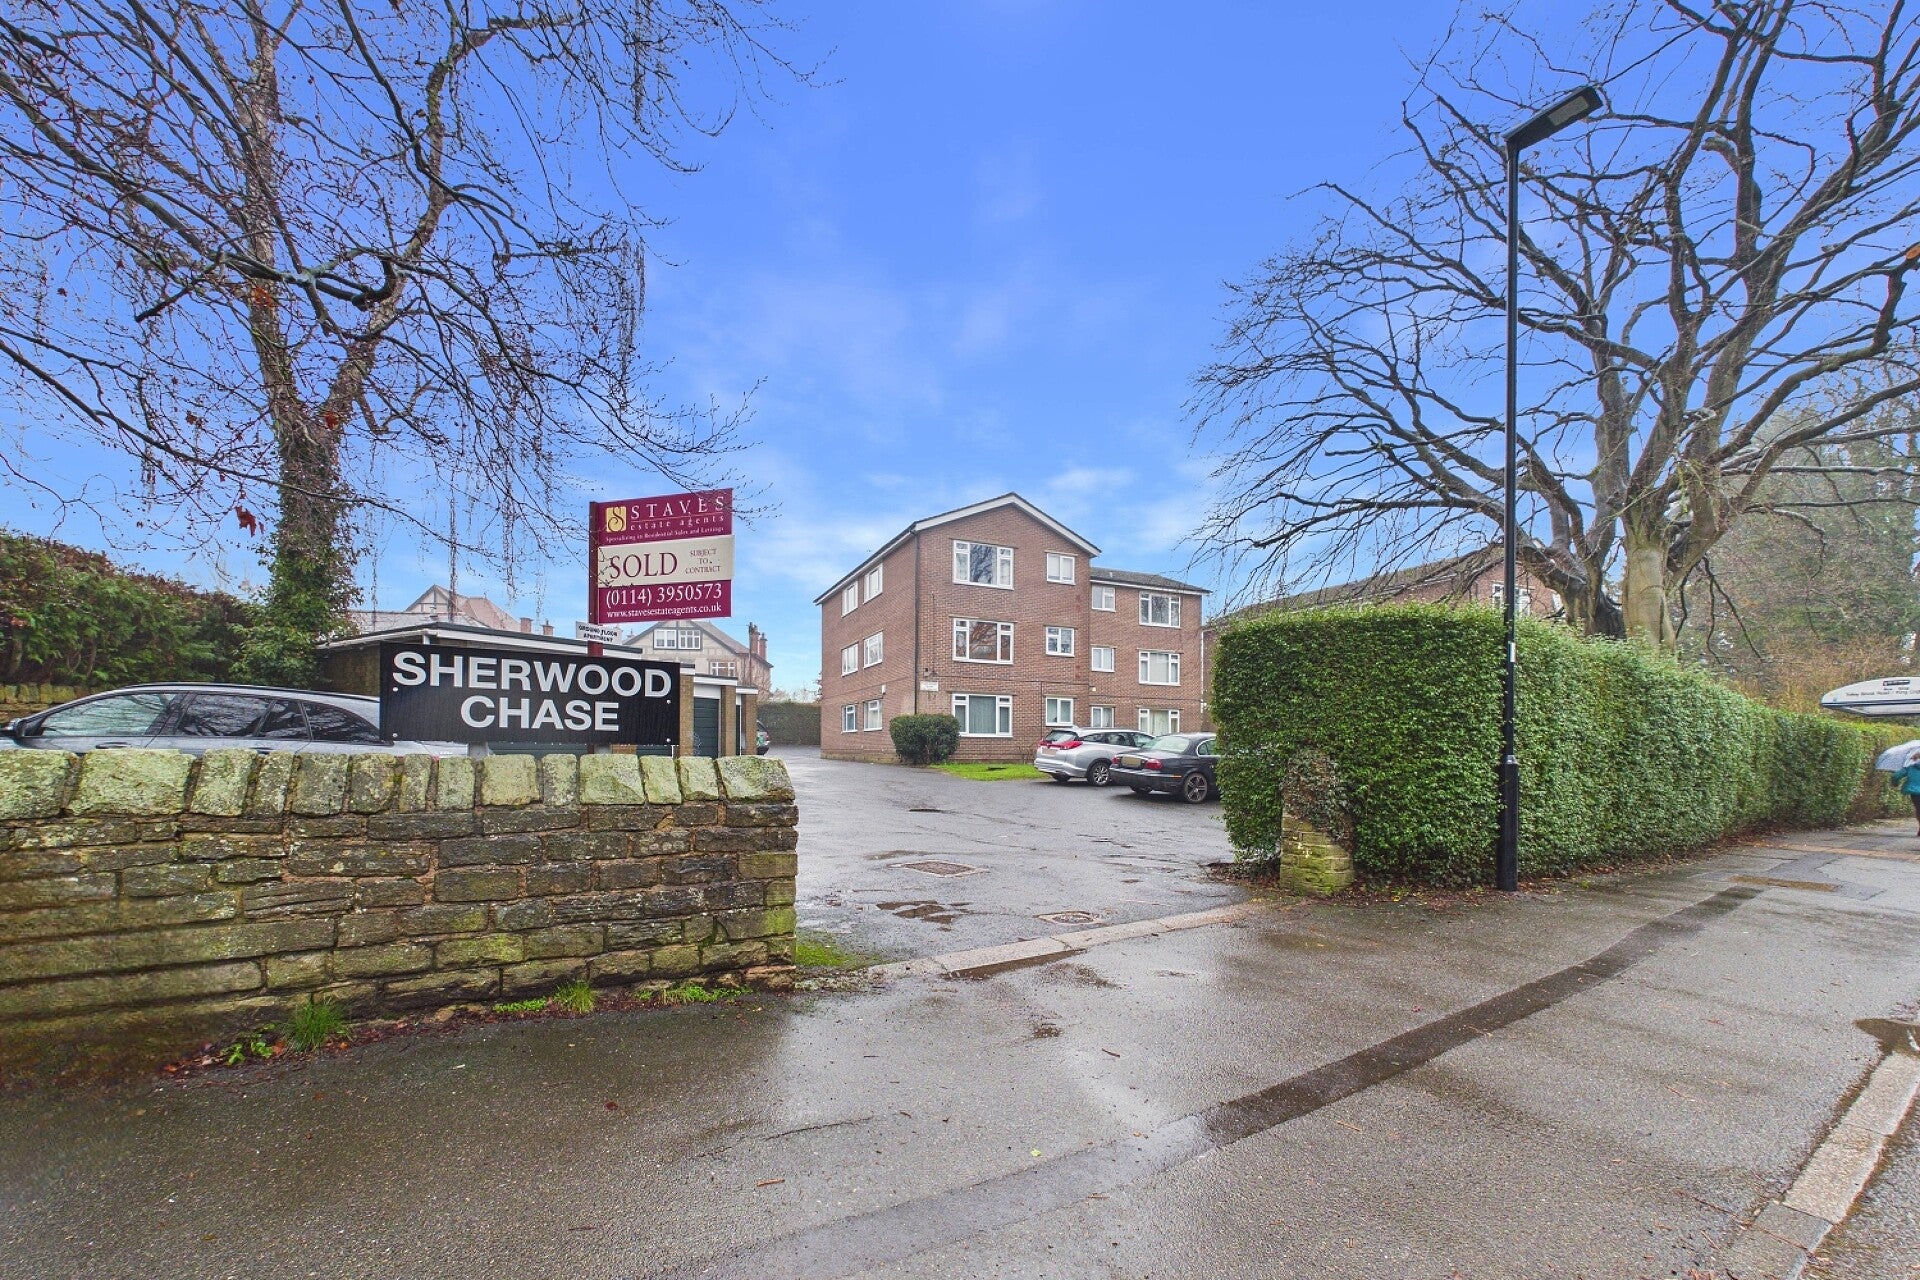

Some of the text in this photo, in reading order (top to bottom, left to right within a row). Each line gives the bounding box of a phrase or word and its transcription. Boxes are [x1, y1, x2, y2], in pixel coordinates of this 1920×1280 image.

[630, 496, 724, 520] STAVES
[630, 515, 724, 531] estate agents
[689, 548, 718, 558] SUBJECT
[698, 557, 709, 565] TO
[609, 552, 678, 580] SOLD
[685, 565, 722, 575] CONTRACT
[606, 583, 723, 609] (0114) 3950573
[606, 601, 723, 618] www.stavesestateagents.co.uk
[392, 651, 672, 698] SHERWOOD
[460, 695, 620, 732] CHASE
